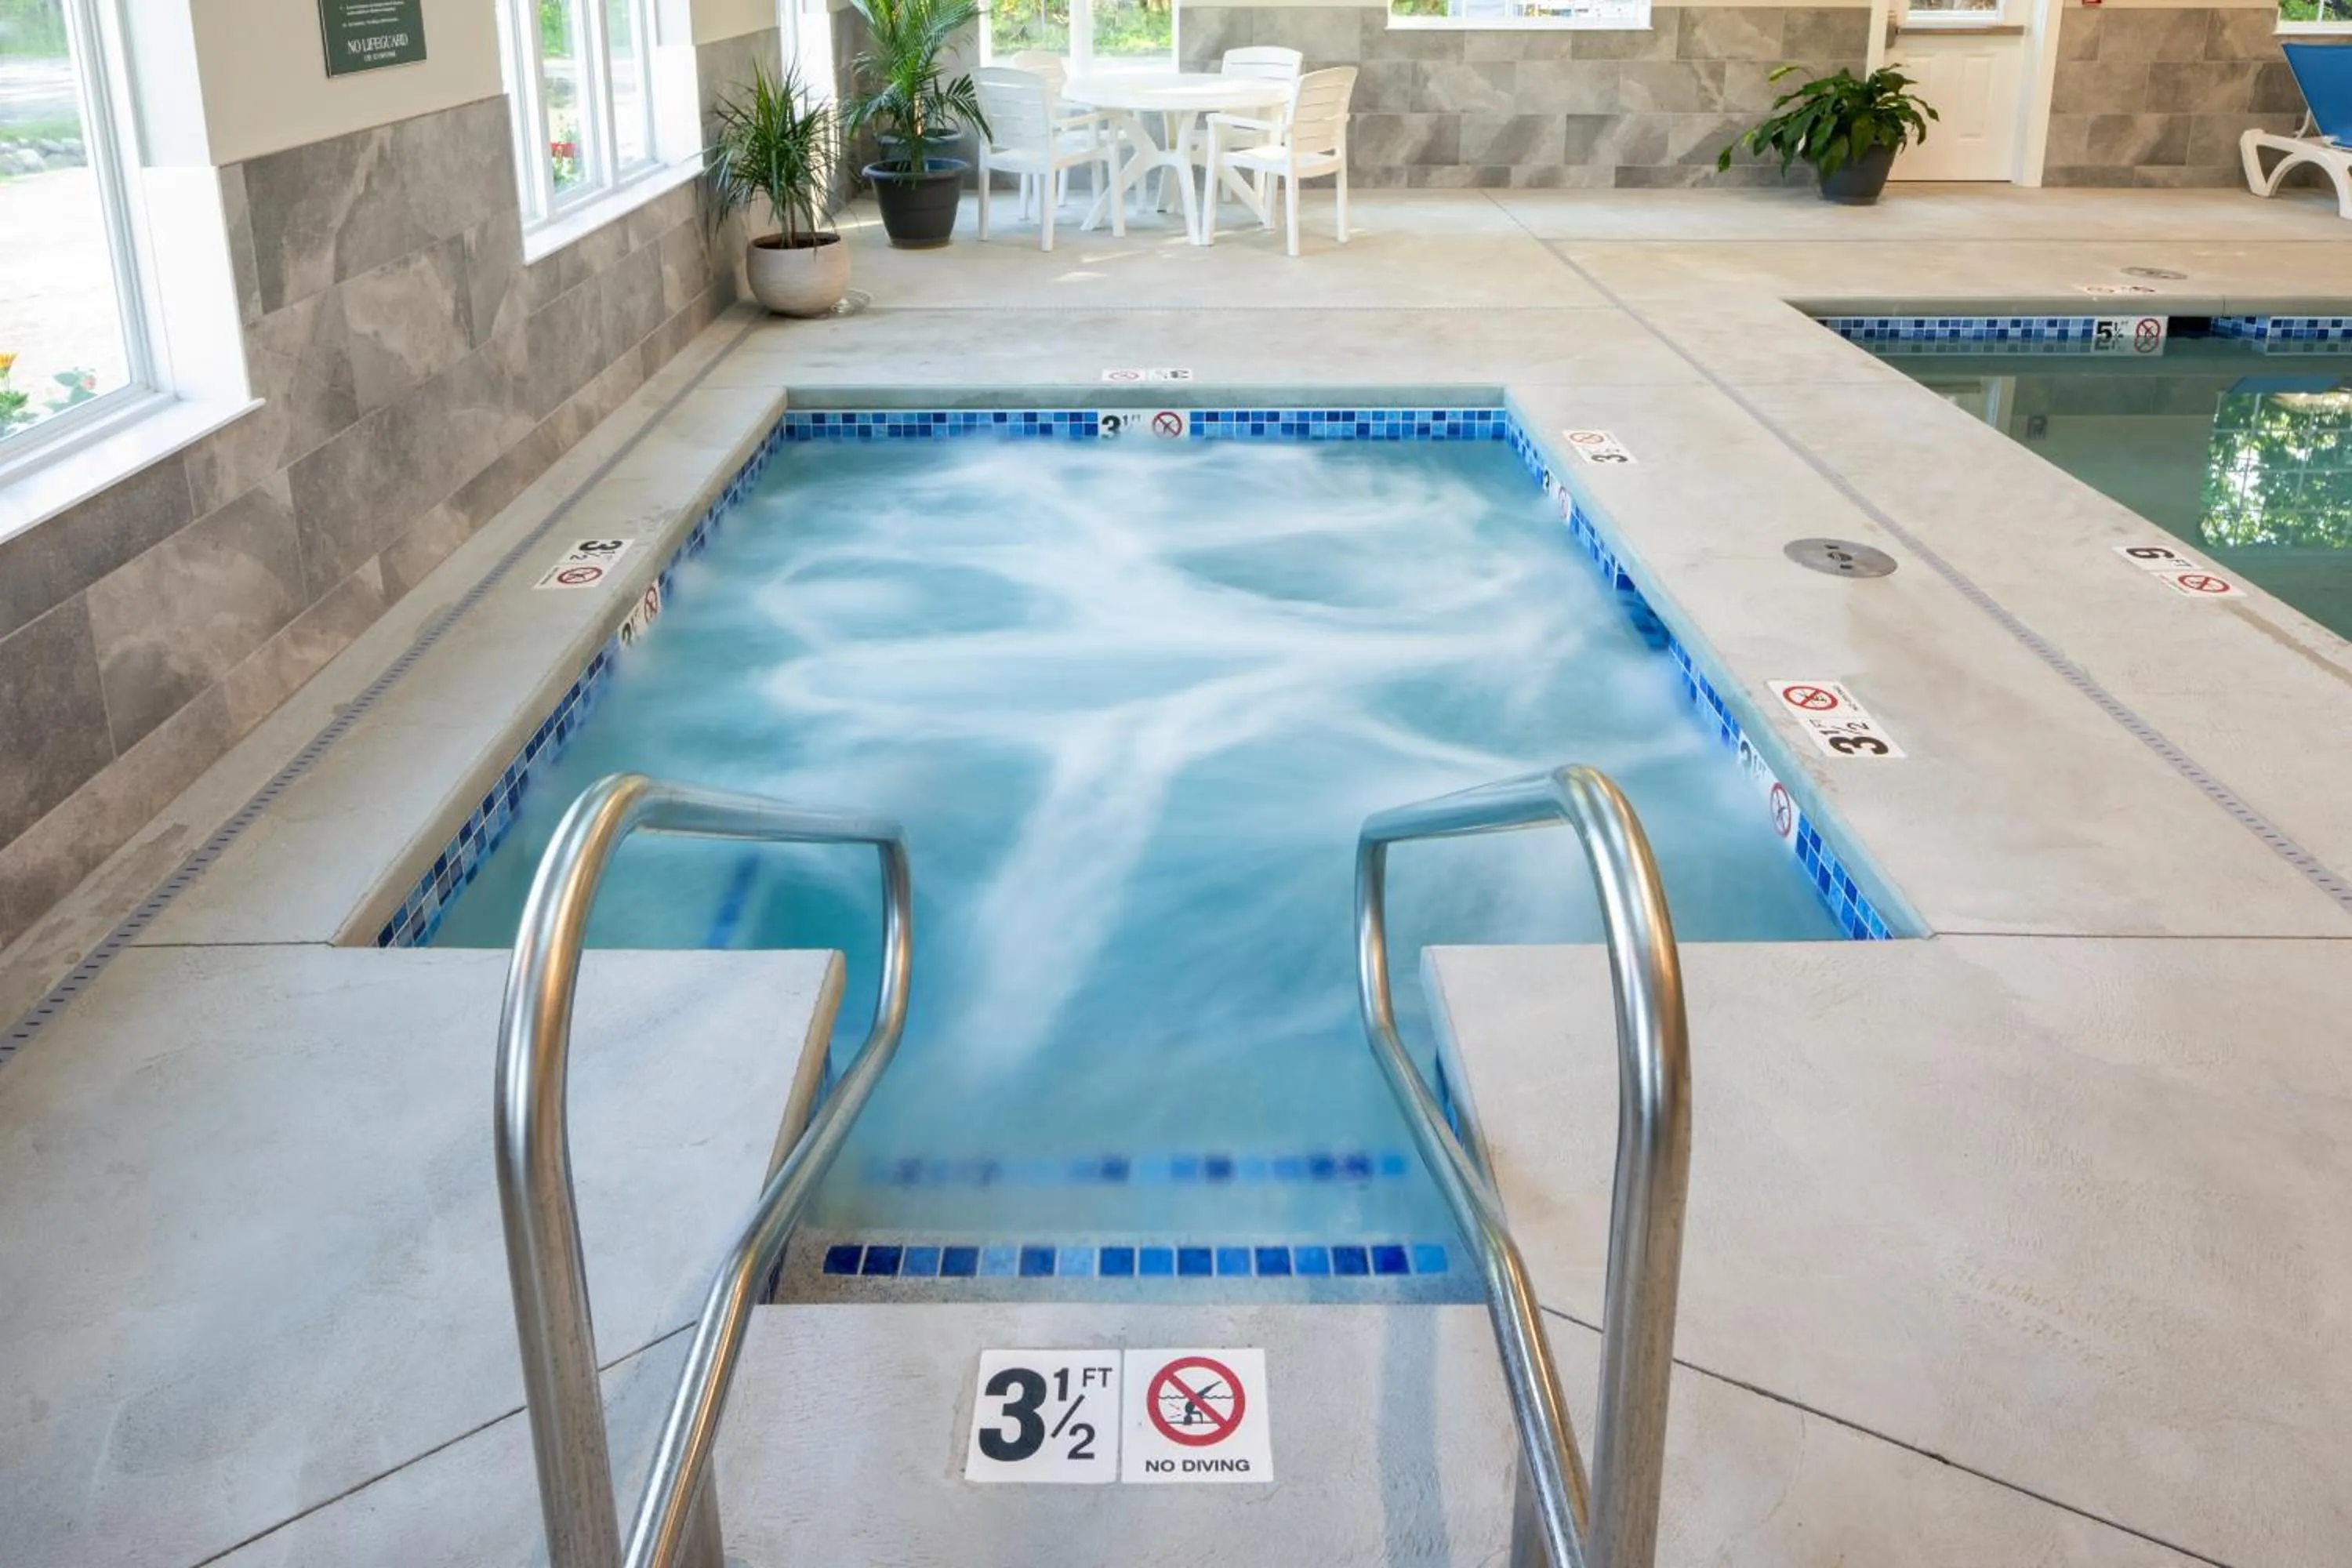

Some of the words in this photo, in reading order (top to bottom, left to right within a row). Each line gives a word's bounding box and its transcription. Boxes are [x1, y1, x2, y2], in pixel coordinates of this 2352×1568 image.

[347, 40, 361, 54] NO
[361, 33, 408, 53] LIFEGUARD
[2097, 321, 2113, 339] 5
[579, 540, 623, 551] 3
[2125, 547, 2176, 559] 6
[1828, 736, 1889, 755] 3
[978, 1367, 1047, 1462] 3
[1082, 1367, 1113, 1388] FT
[1145, 1459, 1175, 1473] NO
[1181, 1458, 1251, 1473] DIVING
